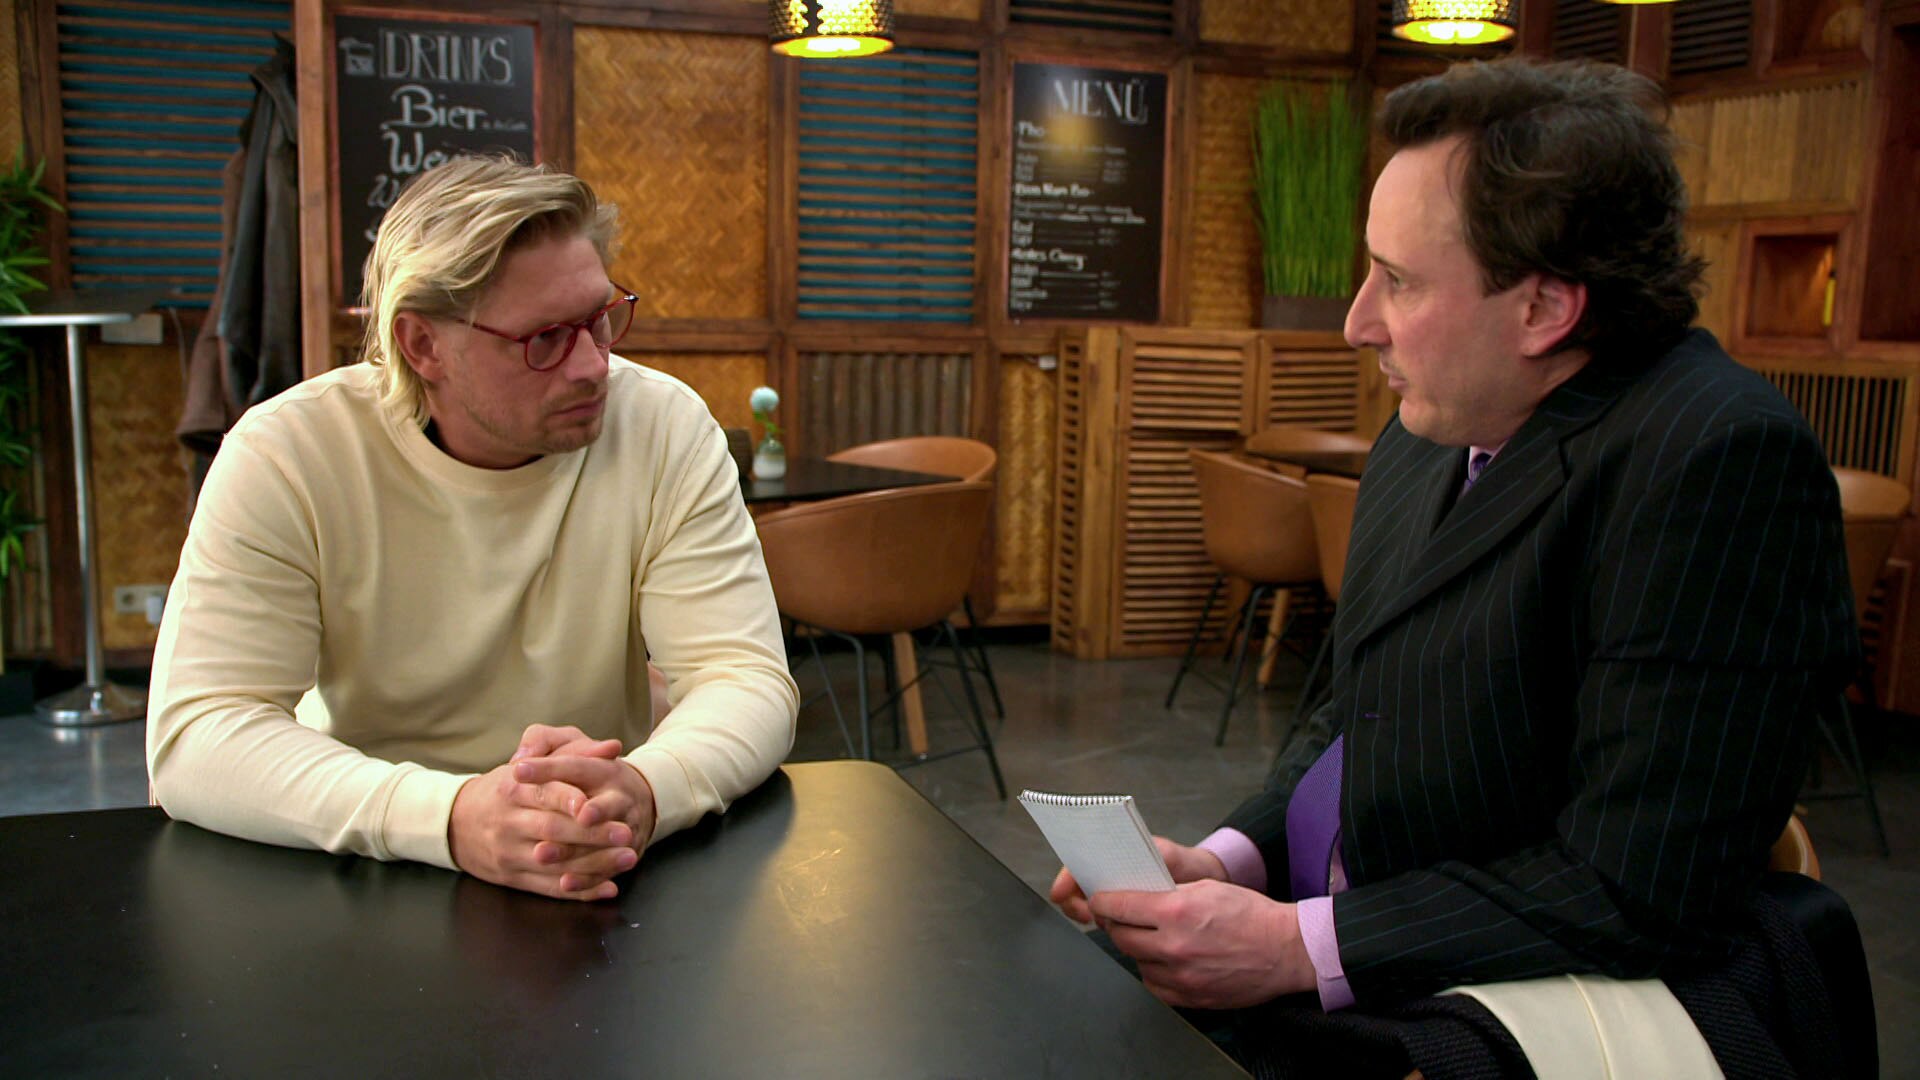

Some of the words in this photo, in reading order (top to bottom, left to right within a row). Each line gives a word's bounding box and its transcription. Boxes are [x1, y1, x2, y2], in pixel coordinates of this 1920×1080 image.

[380, 30, 514, 85] DRINKS
[380, 84, 488, 131] Bier
[383, 130, 471, 174] Wei
